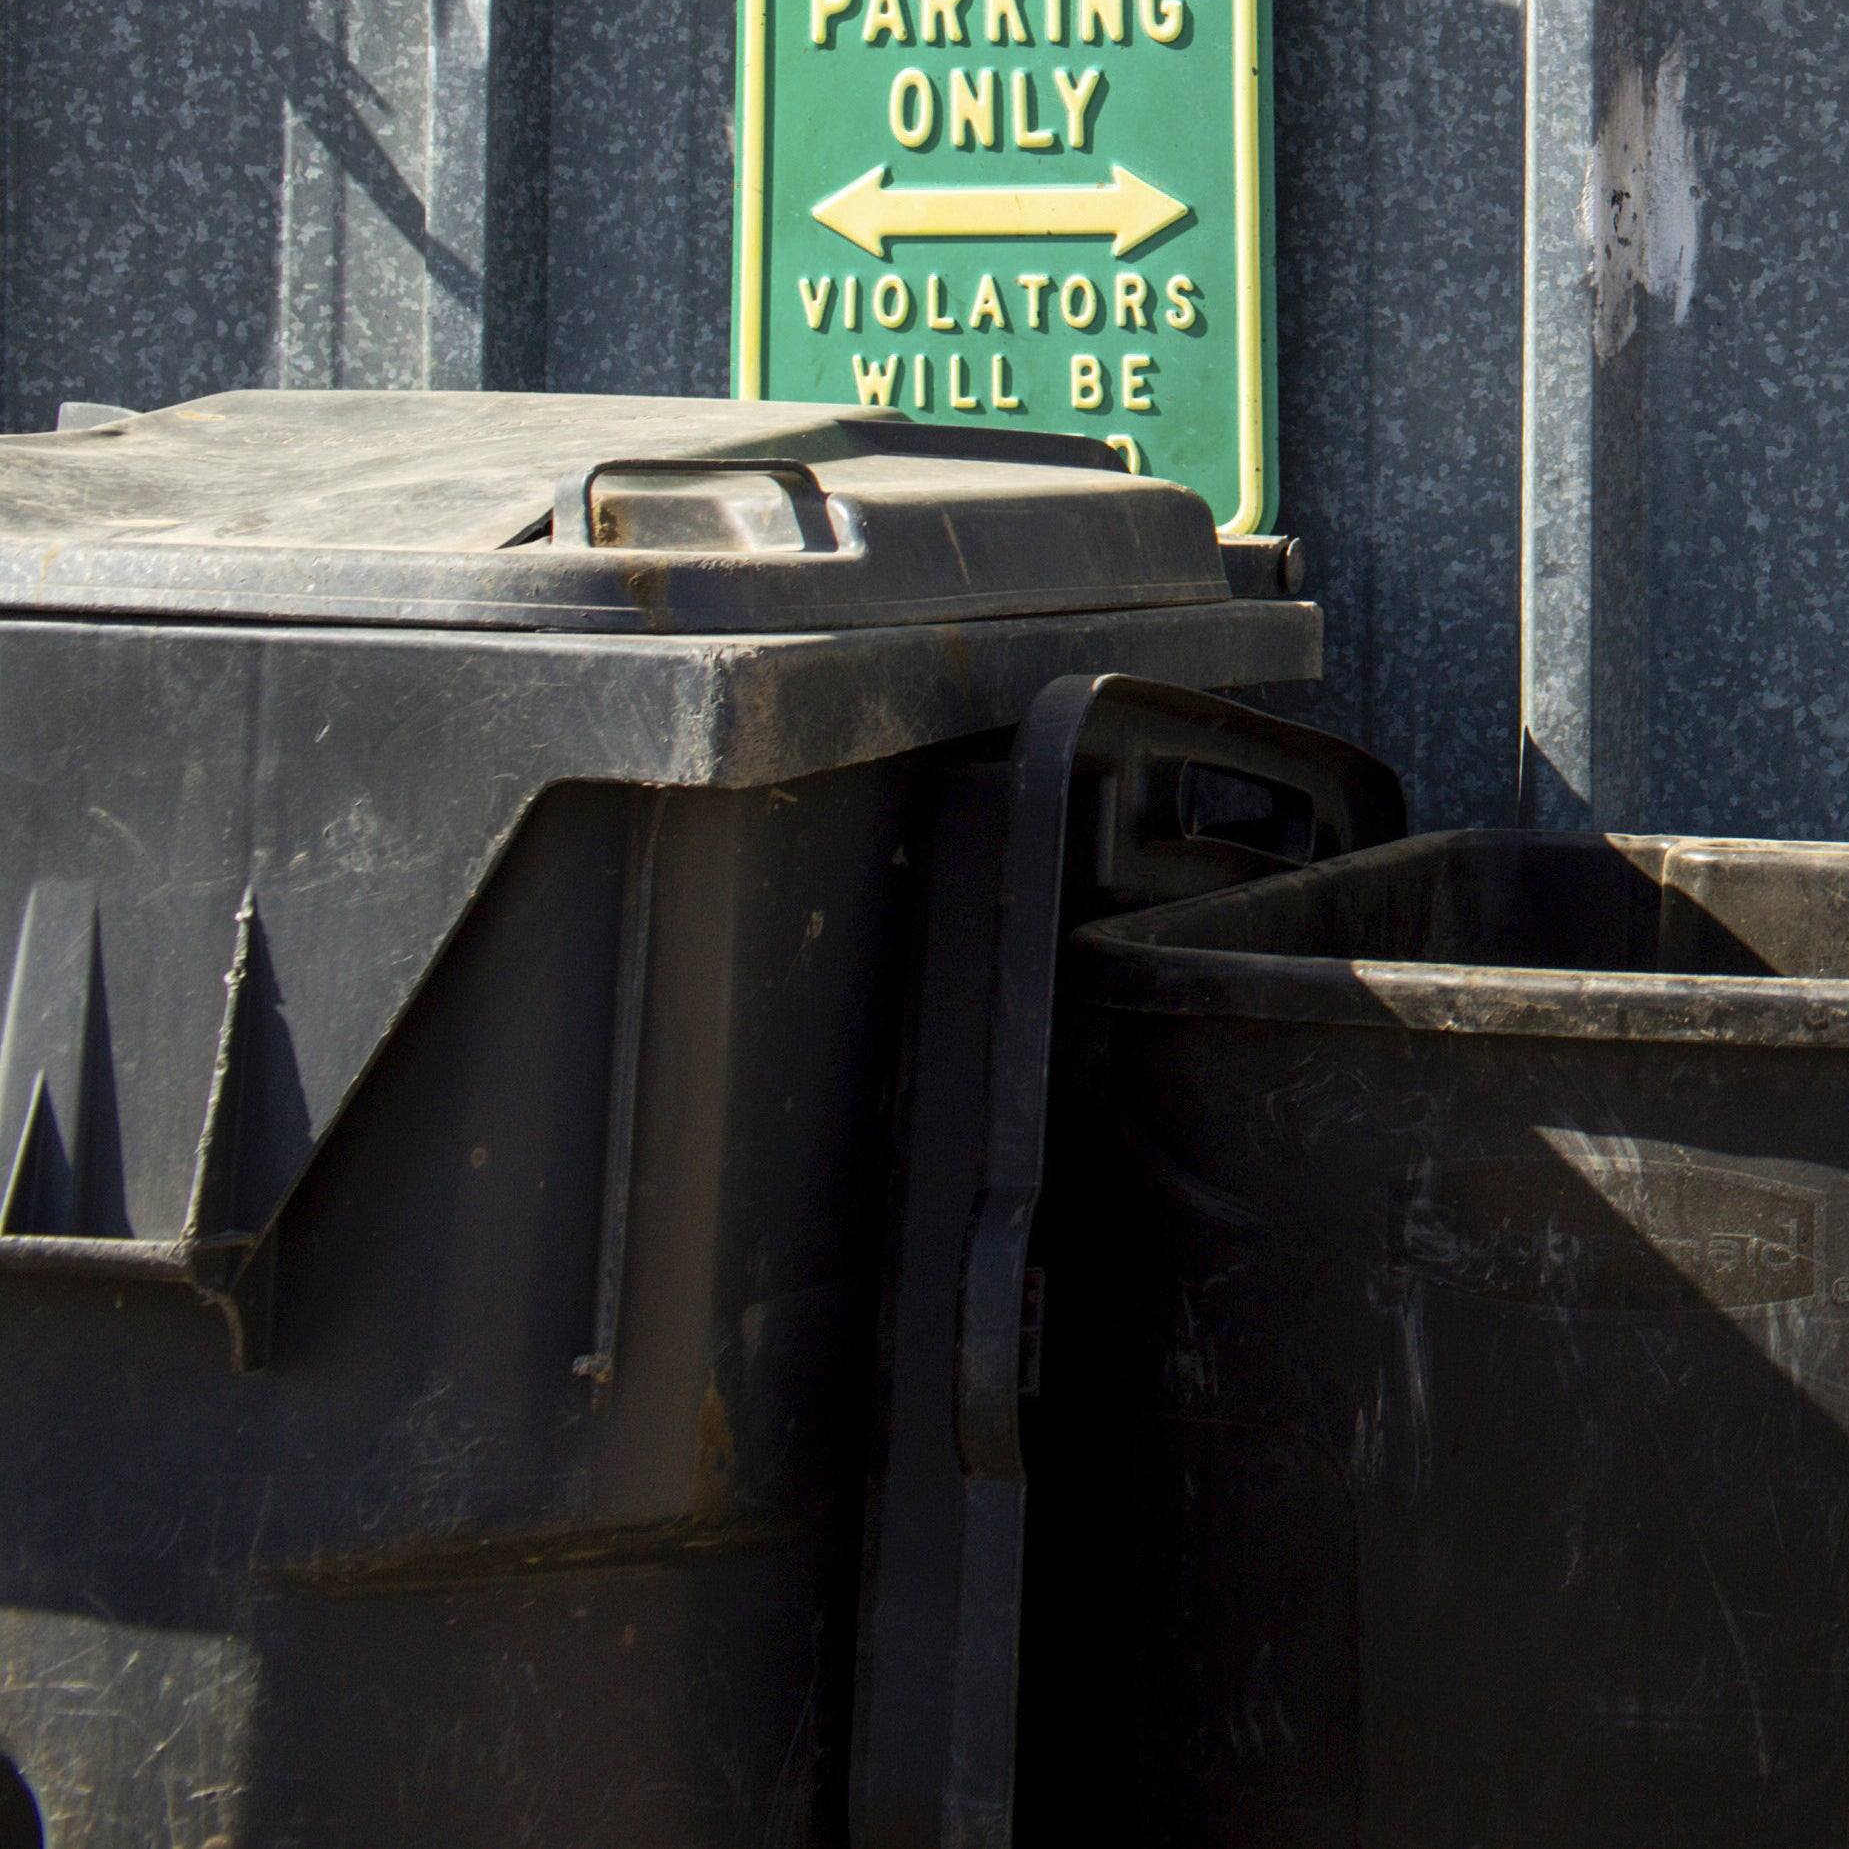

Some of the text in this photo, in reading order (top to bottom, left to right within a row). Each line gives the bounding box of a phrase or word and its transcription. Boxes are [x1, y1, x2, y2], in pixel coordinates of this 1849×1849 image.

[888, 66, 1103, 149] ONLY
[797, 273, 1198, 331] VIOLATORS
[852, 353, 1154, 410] WILL BE
